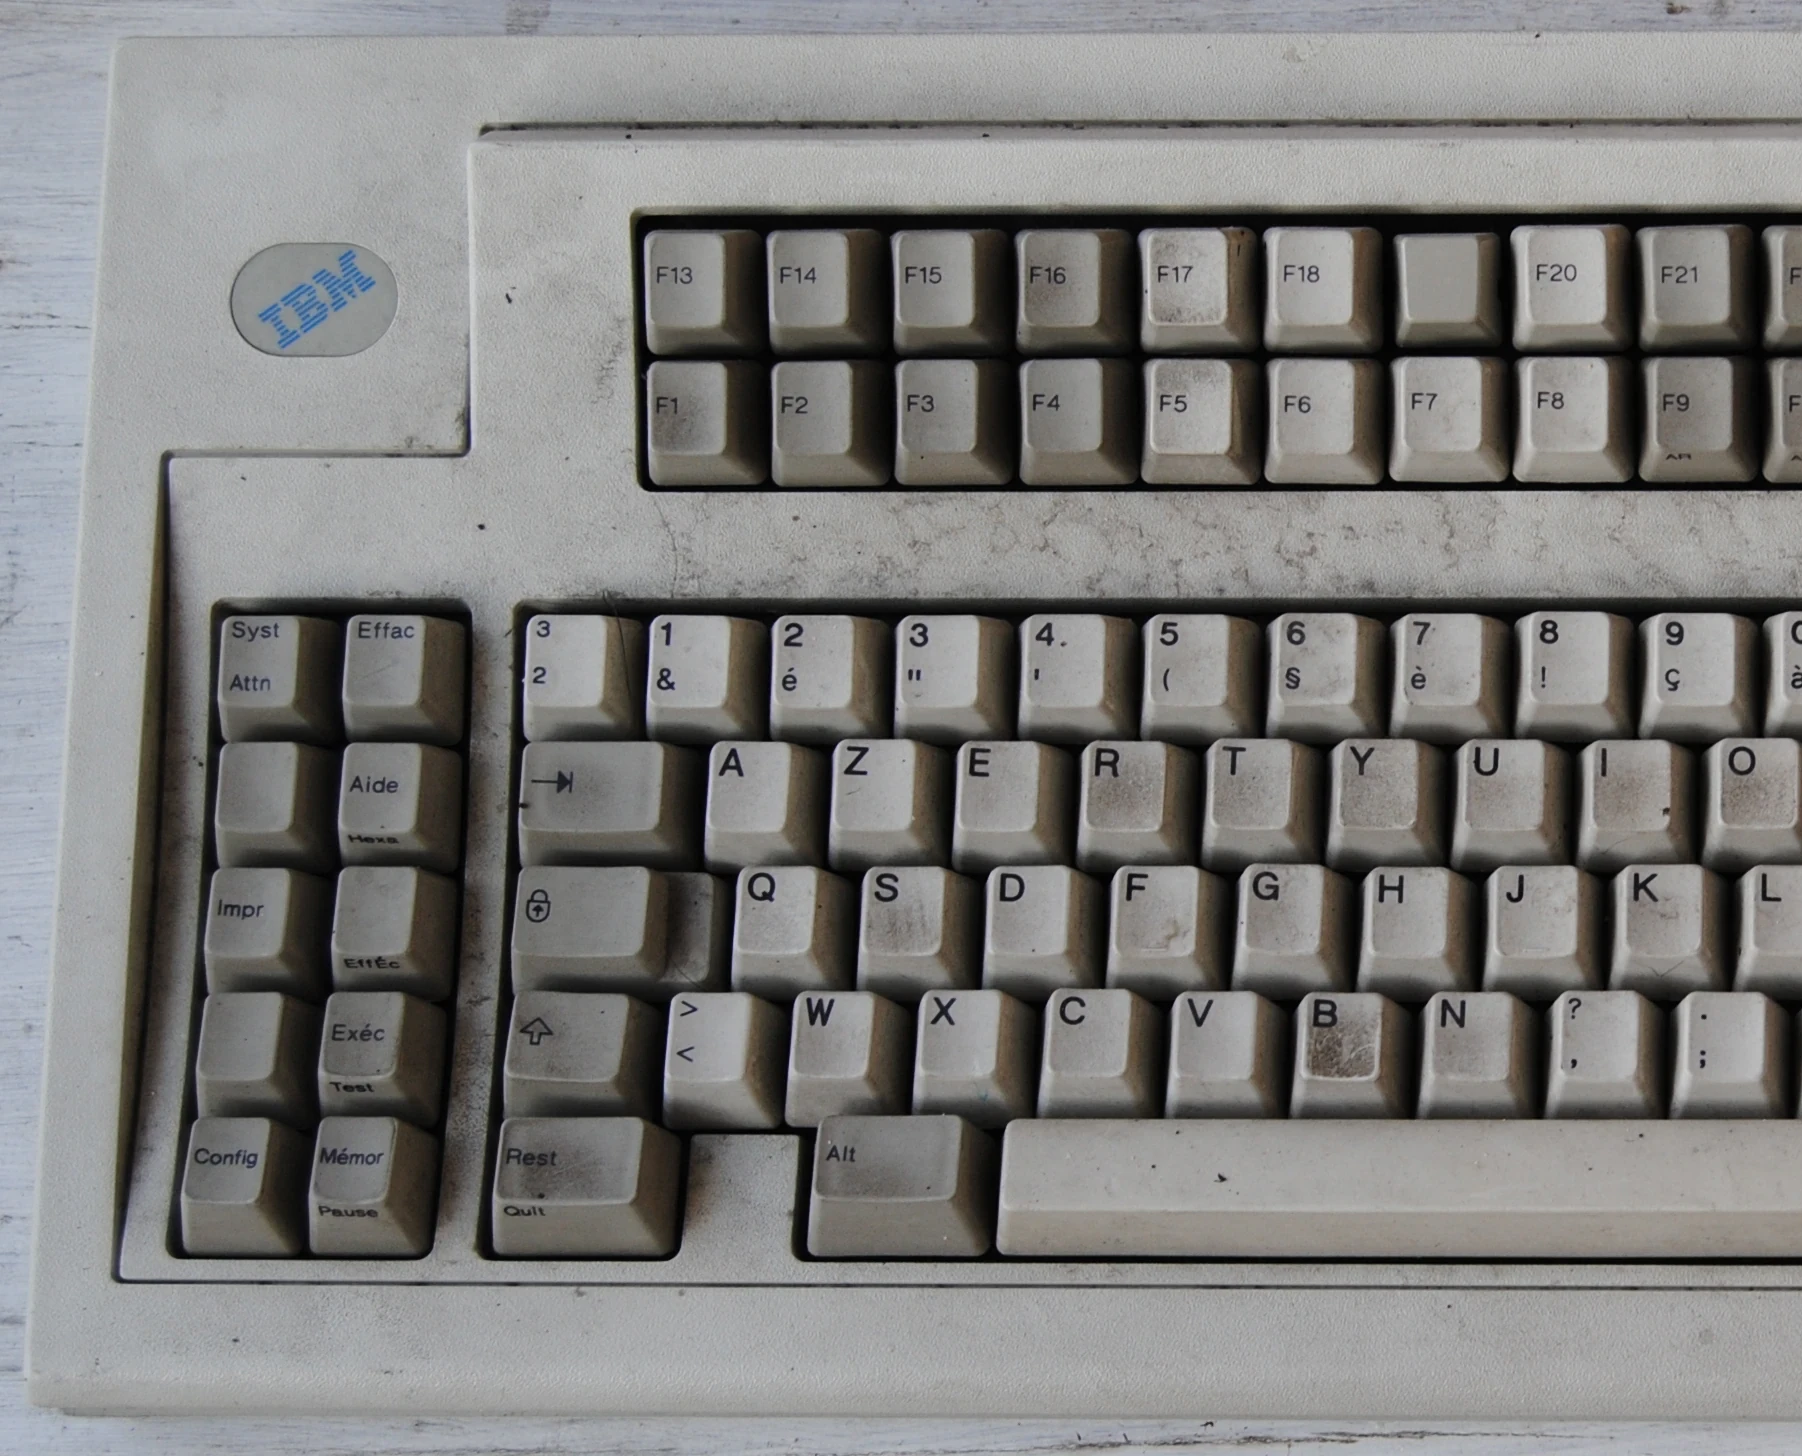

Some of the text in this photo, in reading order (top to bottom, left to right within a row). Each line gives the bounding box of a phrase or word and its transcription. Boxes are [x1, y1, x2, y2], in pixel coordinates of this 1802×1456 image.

[657, 267, 692, 284] F13
[780, 267, 816, 284] F14
[905, 267, 941, 284] F15
[1030, 266, 1066, 284] F16
[1158, 266, 1193, 283] F17
[1284, 265, 1319, 282] F18
[1537, 264, 1577, 281] F20
[1662, 266, 1697, 283] F21
[258, 250, 376, 349] IBM
[656, 397, 677, 414] F1
[781, 396, 808, 414] F2
[907, 395, 934, 412] F3
[1033, 394, 1060, 411] F4
[1160, 394, 1187, 412] F5
[1284, 395, 1311, 413] F6
[1412, 393, 1437, 410] F7
[1538, 392, 1564, 409] F8
[1663, 394, 1689, 411] F9
[232, 621, 279, 642] Syst
[358, 621, 414, 639] Effac
[536, 620, 550, 637] 3
[661, 622, 671, 646] 1
[784, 623, 803, 647] 2
[910, 623, 928, 647] 3
[1036, 623, 1054, 646] 4
[1160, 622, 1178, 646] 5
[1287, 621, 1305, 645] 6
[1413, 621, 1430, 645] 7
[1540, 620, 1558, 644] 8
[1666, 622, 1684, 645] 9
[229, 674, 270, 691] Attn
[533, 667, 546, 684] 2
[657, 668, 675, 690] &
[782, 668, 797, 691] é
[1163, 669, 1169, 691] (
[1285, 667, 1300, 689] §
[1411, 666, 1426, 689] è
[1541, 666, 1545, 688] !
[1665, 669, 1680, 691] ç
[719, 748, 743, 777] A
[844, 746, 869, 775] Z
[969, 748, 991, 777] E
[1095, 748, 1119, 777] R
[1223, 746, 1246, 775] T
[1350, 746, 1374, 775] Y
[1474, 747, 1499, 776] U
[1601, 748, 1607, 777] I
[1729, 746, 1755, 775] O
[350, 776, 398, 793] Aide
[348, 834, 399, 844] Hexa
[748, 873, 775, 902] Q
[875, 873, 898, 902] S
[1000, 873, 1025, 902] D
[1126, 873, 1148, 901] F
[1253, 871, 1279, 900] G
[1378, 875, 1404, 903] H
[1506, 875, 1524, 903] J
[1633, 873, 1658, 902] K
[1762, 873, 1781, 902] L
[218, 900, 264, 920] Impr
[680, 1001, 697, 1016] >
[806, 998, 834, 1026] W
[931, 997, 956, 1025] X
[1060, 997, 1085, 1025] C
[1188, 998, 1213, 1027] V
[1313, 999, 1337, 1028] B
[1441, 999, 1466, 1028] N
[1569, 998, 1581, 1019] ?
[332, 1024, 385, 1041] Exéc
[677, 1047, 694, 1062] <
[1700, 1050, 1706, 1068] ;
[329, 1082, 373, 1092] Test
[194, 1148, 258, 1168] Config
[319, 1148, 384, 1165] Mémor
[505, 1148, 557, 1166] Rest
[825, 1145, 855, 1162] Alt
[318, 1206, 378, 1217] Pause
[504, 1206, 545, 1216] Quit
